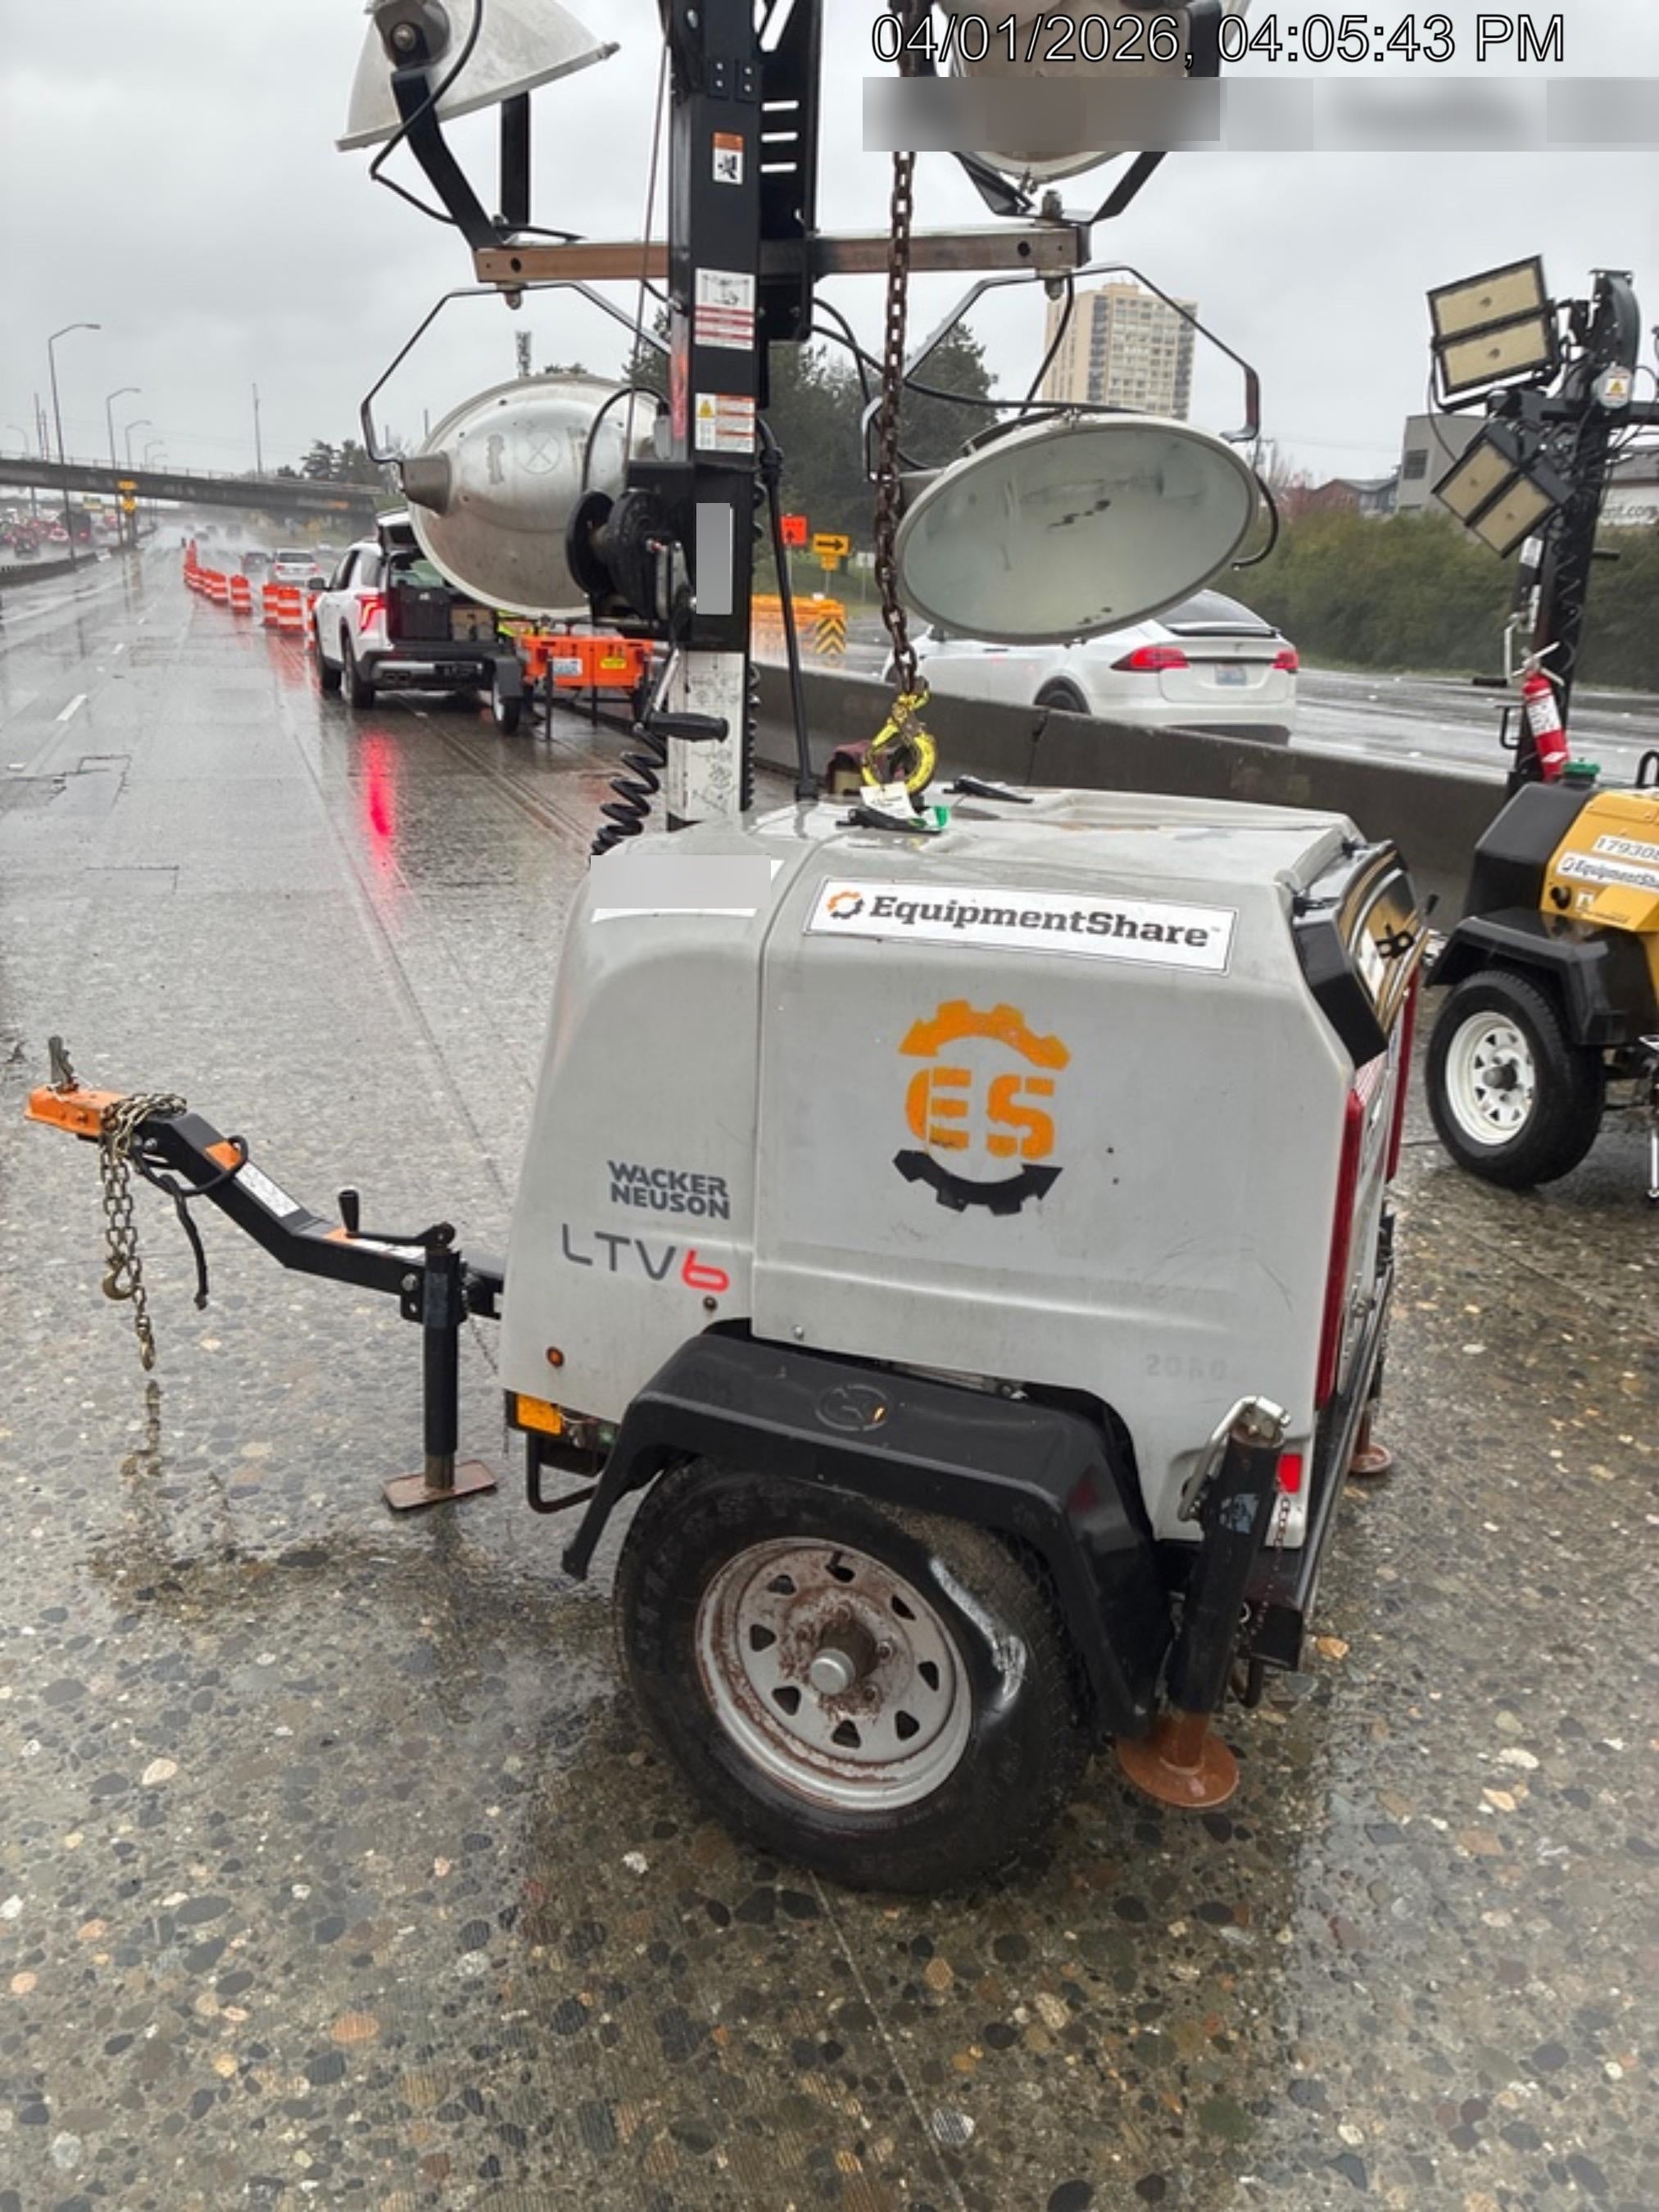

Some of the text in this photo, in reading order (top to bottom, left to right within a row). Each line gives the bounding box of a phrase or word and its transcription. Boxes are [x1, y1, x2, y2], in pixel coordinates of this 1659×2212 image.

[906, 1067, 1054, 1160] ES
[607, 1159, 728, 1198] WACKER
[611, 1184, 730, 1219] NEUSON
[561, 1223, 729, 1292] LTV6
